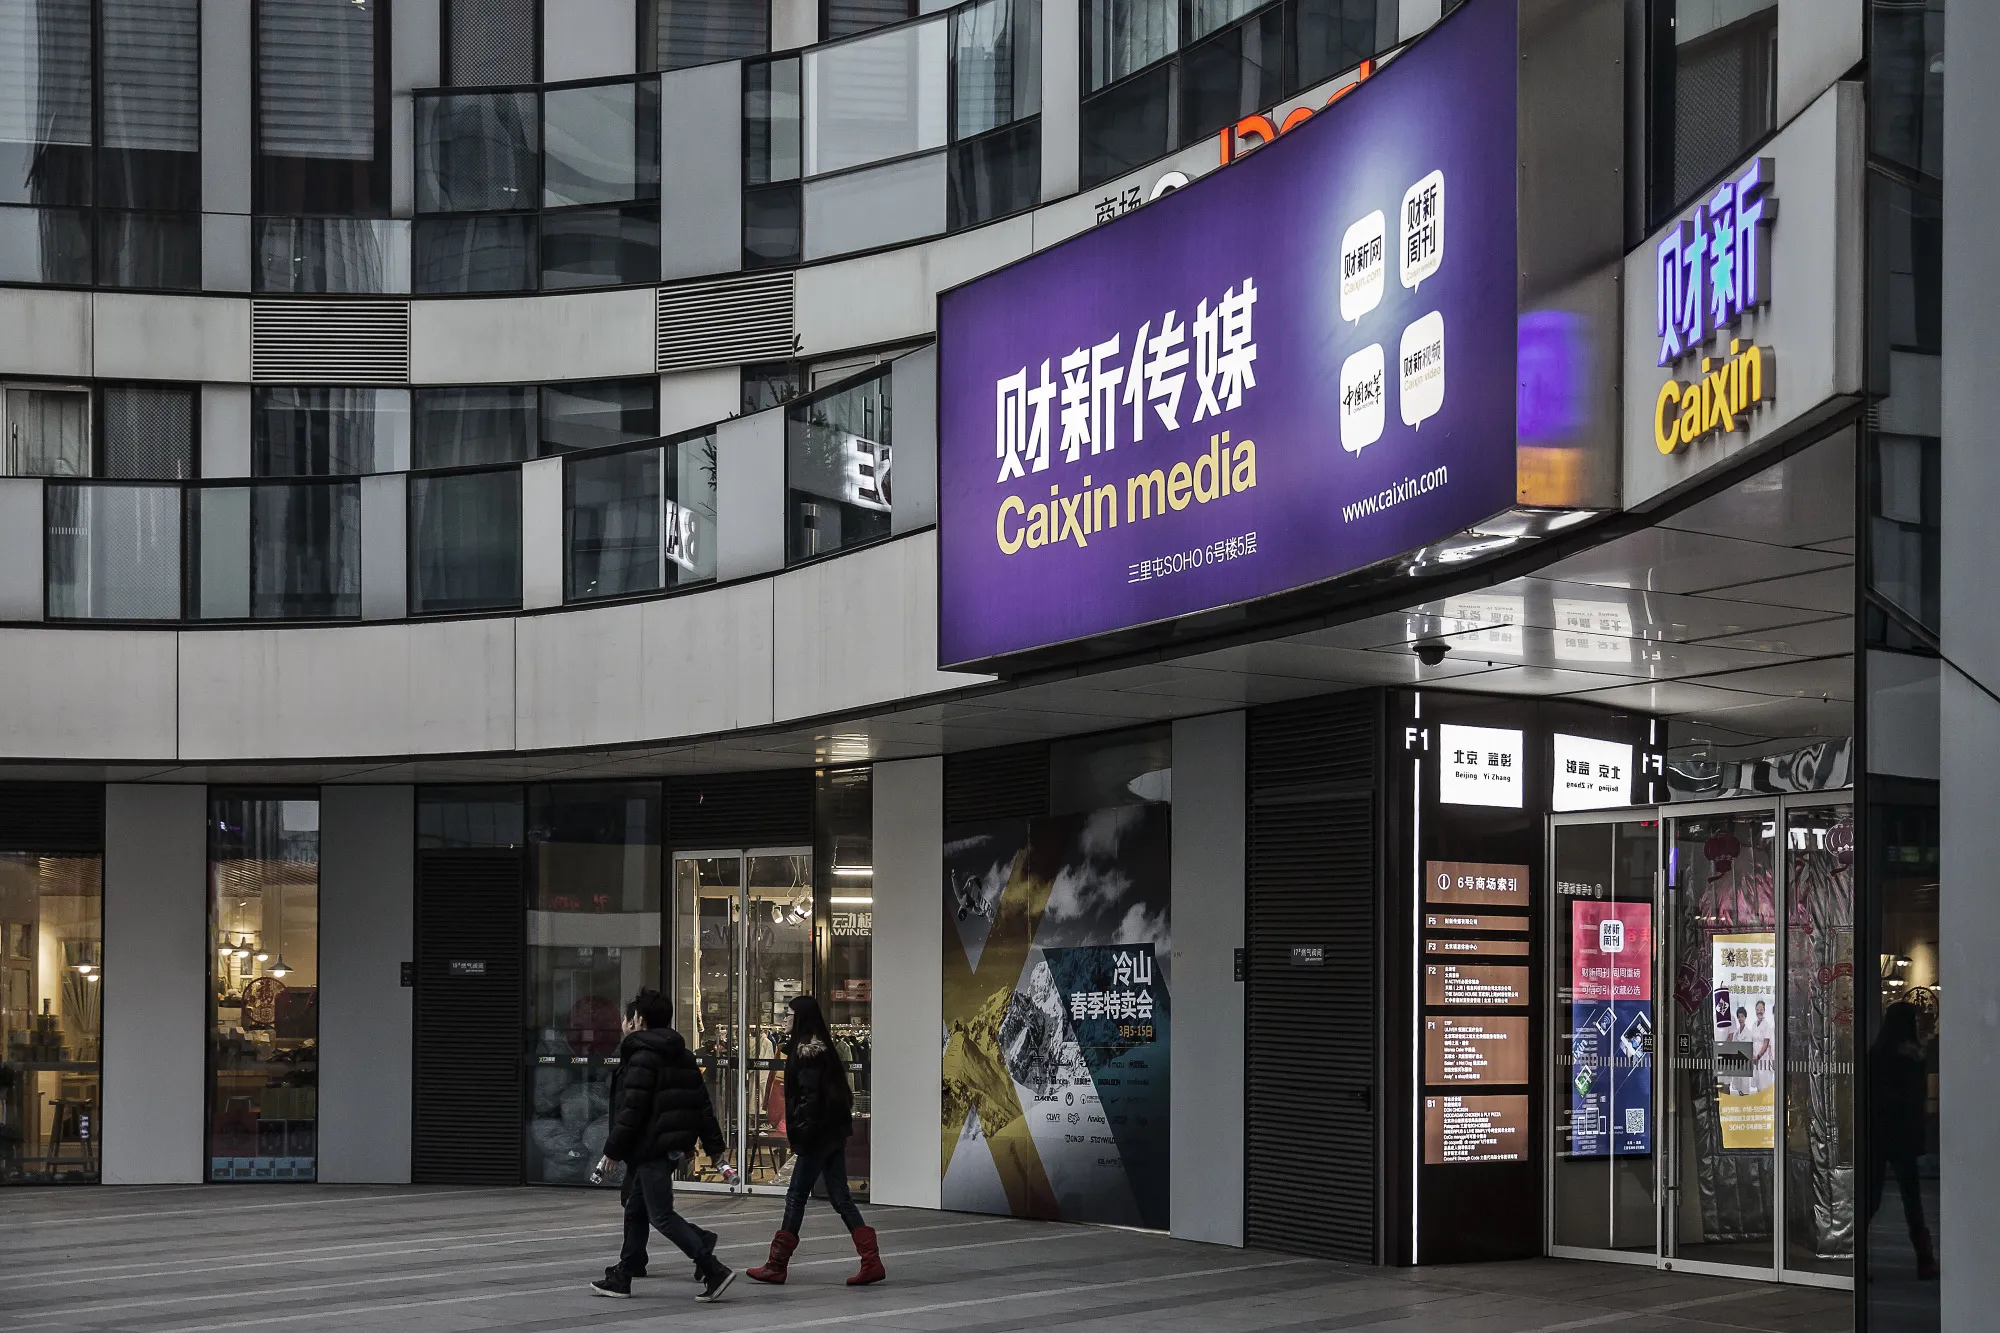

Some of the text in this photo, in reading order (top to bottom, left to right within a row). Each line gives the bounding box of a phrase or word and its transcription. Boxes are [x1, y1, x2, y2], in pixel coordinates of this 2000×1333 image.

[1407, 182, 1437, 232] 财新
[1407, 219, 1436, 268] 周刊
[1345, 234, 1382, 280] 财新网
[1657, 157, 1766, 367] 财新
[1344, 266, 1382, 295] Caixin.com
[1404, 340, 1441, 377] 财新视频
[996, 277, 1257, 483] 财新传媒
[1404, 367, 1441, 391] Caixin video
[1654, 337, 1762, 455] Caixin
[996, 430, 1257, 555] Caixin media
[1342, 465, 1448, 523] www.caixin.com
[1127, 532, 1257, 583] 三里屯SOHO 6号楼5层
[1405, 727, 1429, 750] F1
[1453, 749, 1478, 765] 北京
[1455, 770, 1511, 783] Beijing Yi Zhang
[1457, 876, 1517, 891] 6号商场索引
[1428, 917, 1437, 925] F5
[1603, 923, 1620, 935] 财新
[1428, 943, 1437, 951] F3
[1603, 935, 1620, 947] 周刊
[1112, 950, 1152, 986] 冷山
[1428, 966, 1437, 974] F2
[1581, 967, 1610, 978] 财新周刊
[1070, 989, 1153, 1020] 春季特卖会
[1119, 1024, 1153, 1038] 3月5-15日
[1427, 1021, 1436, 1030] F1
[1644, 1036, 1653, 1047] 拉
[1427, 1099, 1436, 1108] B1
